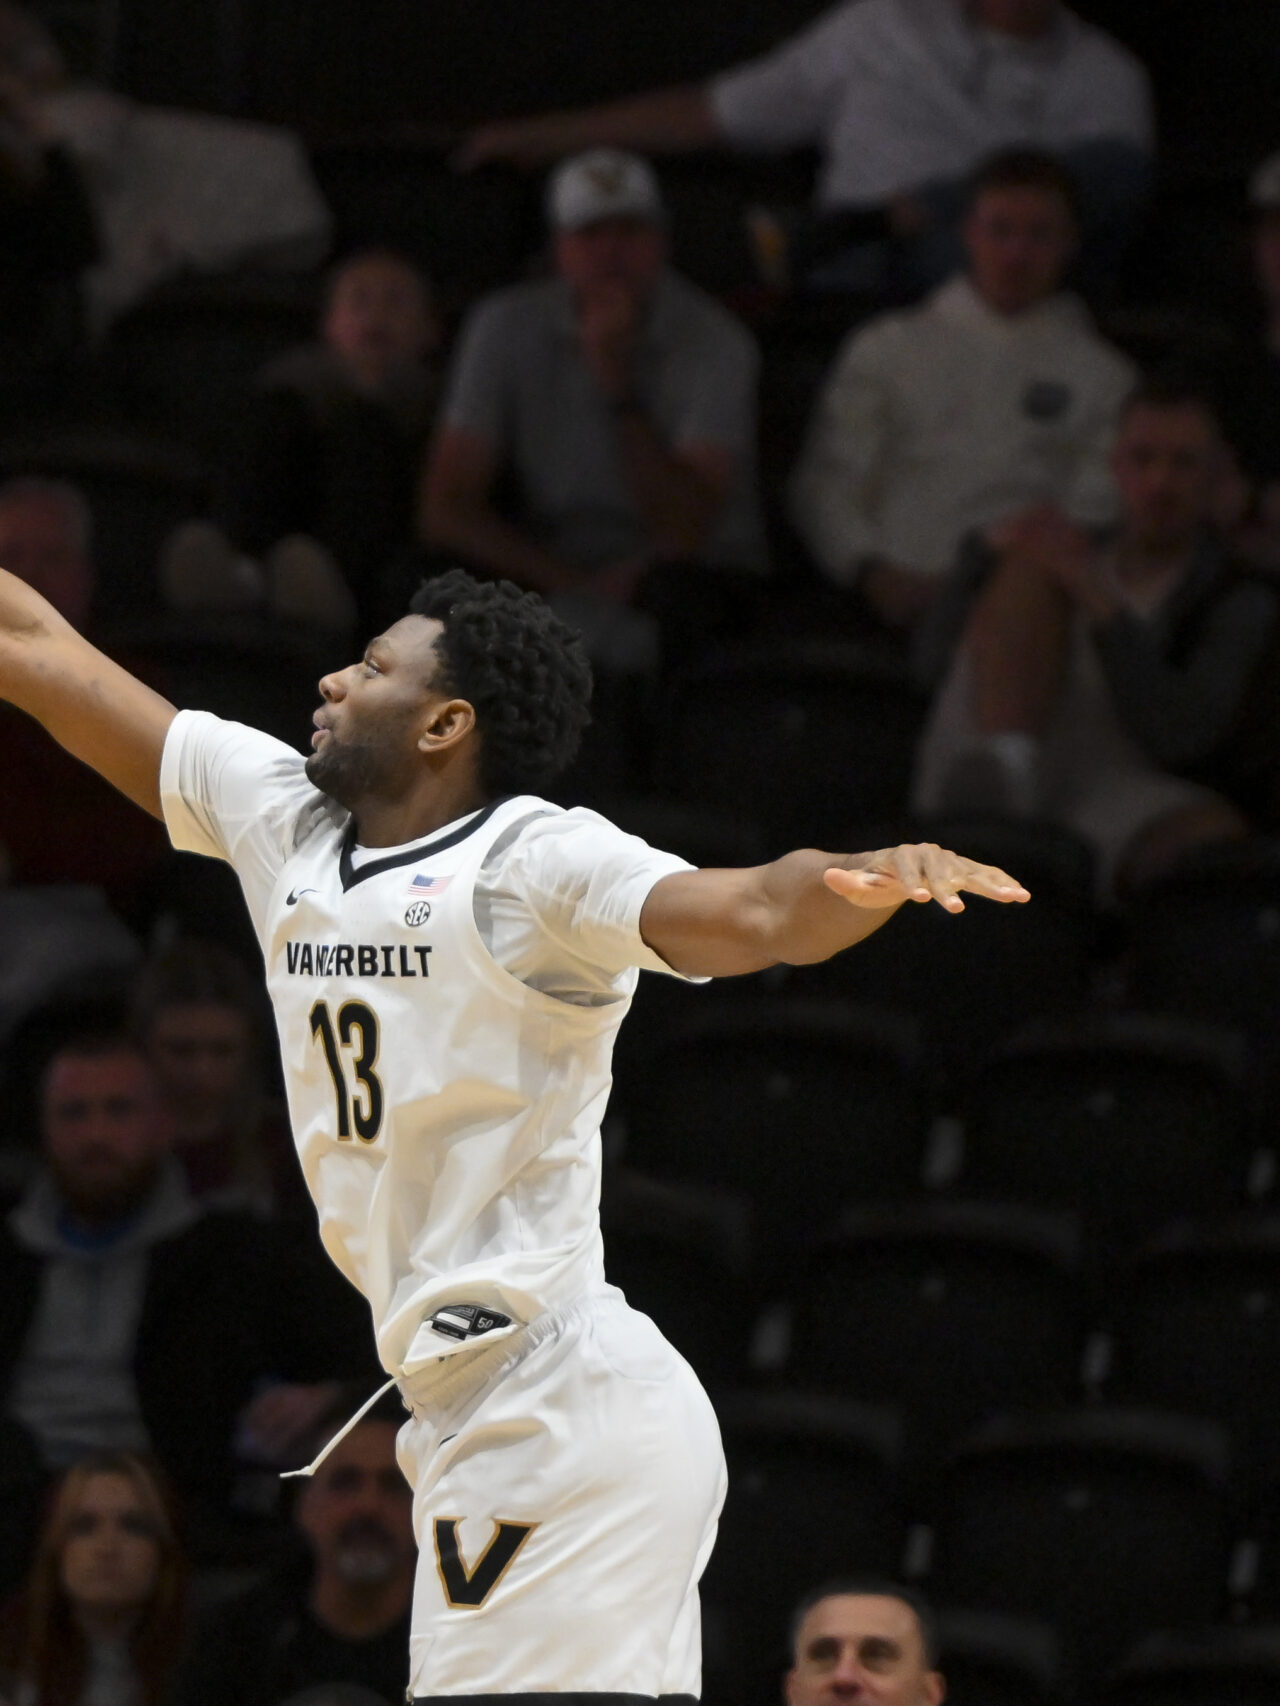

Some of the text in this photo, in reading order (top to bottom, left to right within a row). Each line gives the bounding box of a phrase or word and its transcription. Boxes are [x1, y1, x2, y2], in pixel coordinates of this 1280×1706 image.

[406, 902, 430, 926] SEC
[286, 941, 433, 978] VANDERBILT
[308, 999, 385, 1145] 13
[476, 1316, 494, 1329] 50
[433, 1516, 543, 1610] V
